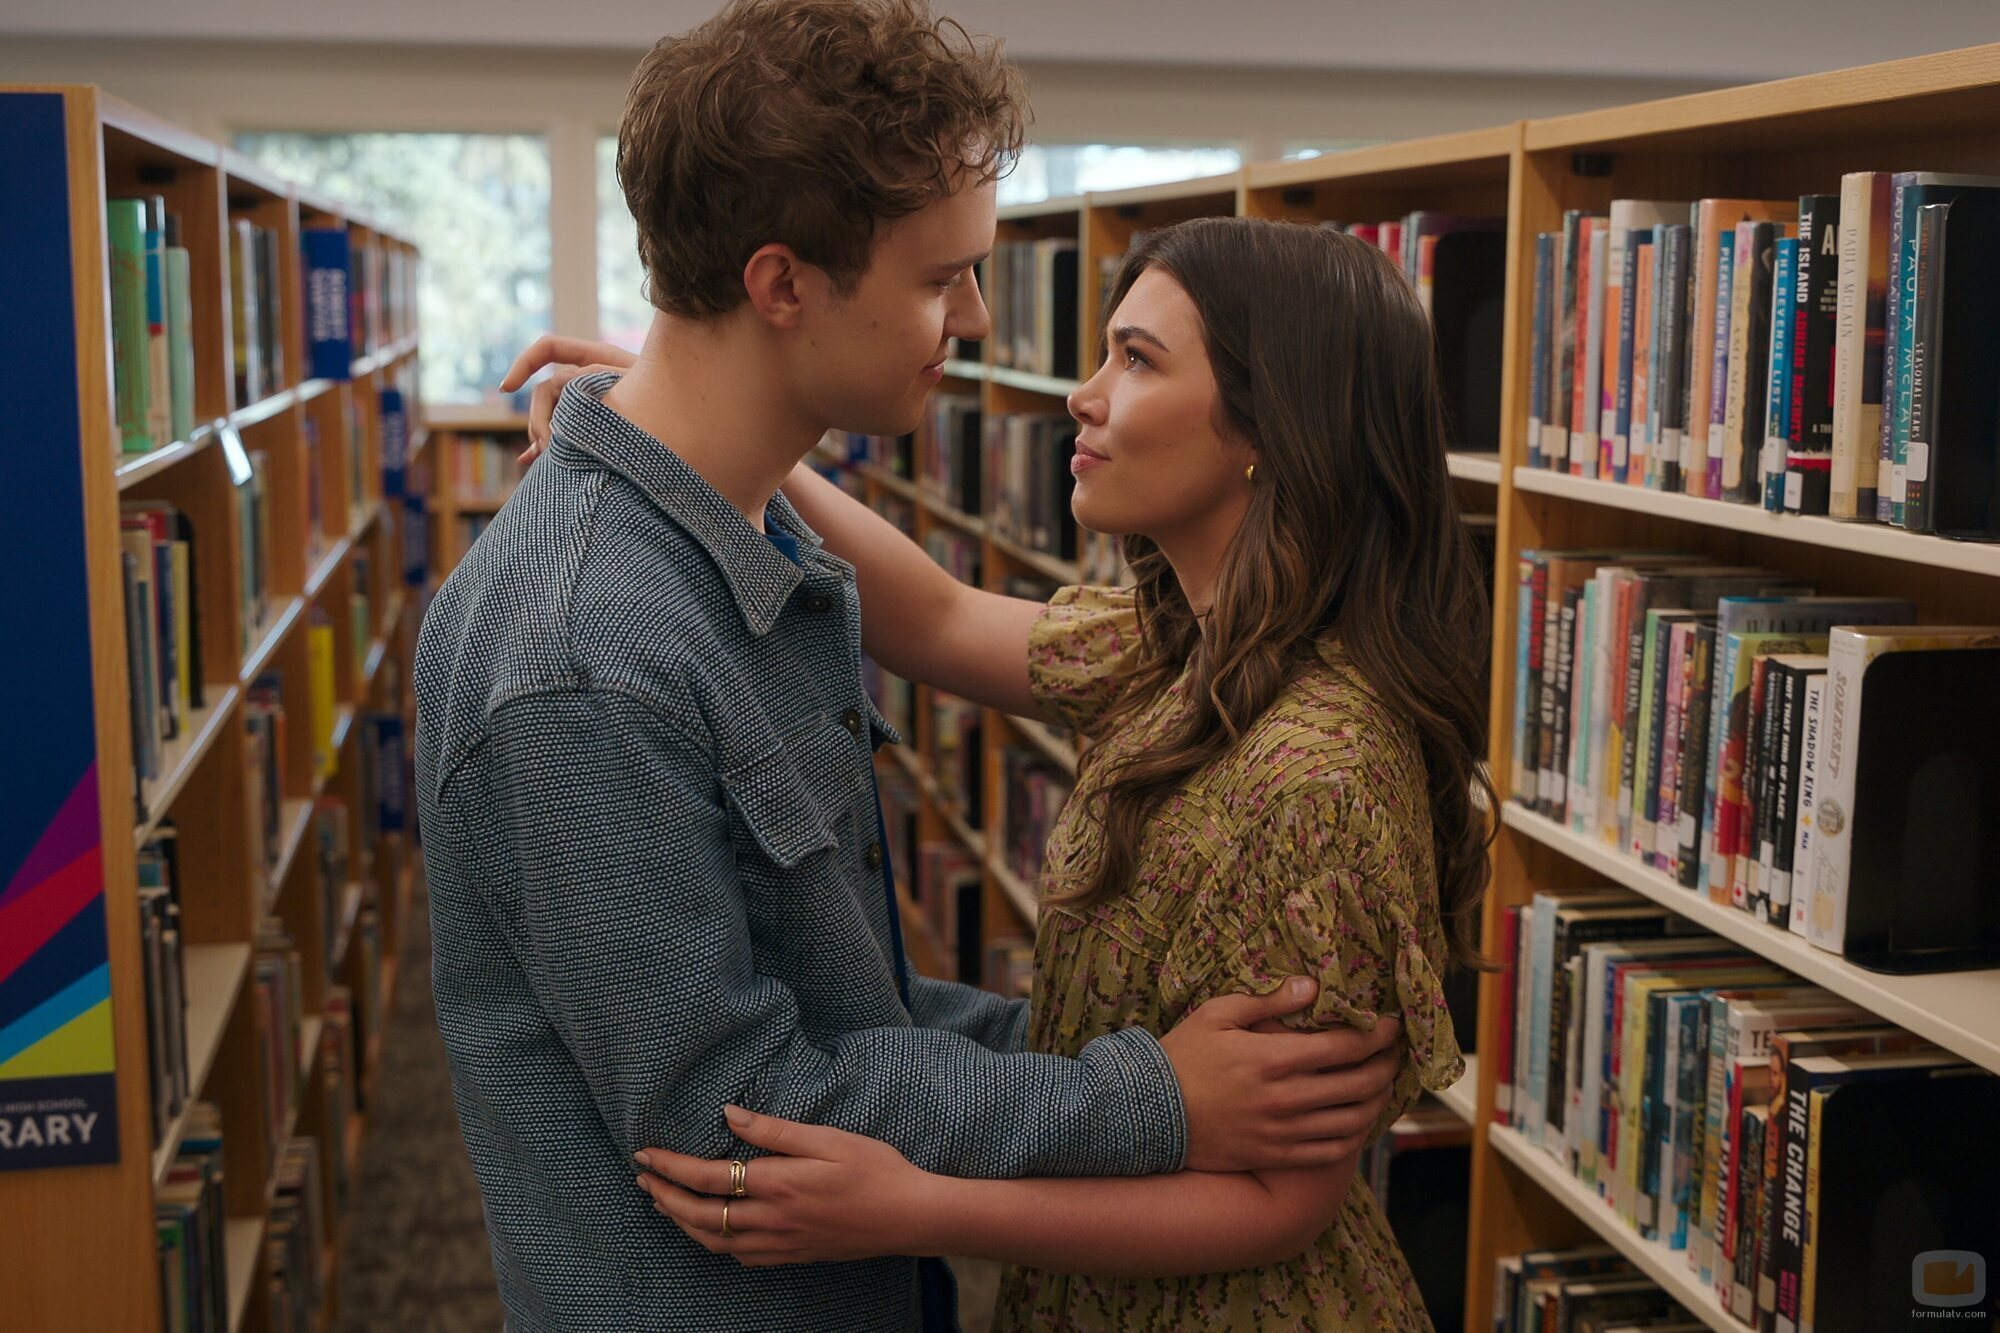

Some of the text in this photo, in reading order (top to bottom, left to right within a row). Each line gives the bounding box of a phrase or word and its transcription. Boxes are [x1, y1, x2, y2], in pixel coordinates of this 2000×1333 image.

[1800, 211, 1813, 241] THE
[1893, 185, 1905, 243] PAULA
[1718, 246, 1731, 297] PLEASE
[1779, 247, 1789, 278] THE
[1796, 246, 1811, 304] ISLAND
[1843, 228, 1858, 277] PAULA
[1890, 252, 1901, 317] McLAIN
[1904, 239, 1918, 332] PAULA
[1716, 303, 1728, 334] JOIN
[1774, 287, 1787, 362] REVENGE
[1793, 310, 1808, 367] ADRIAN
[1771, 369, 1781, 405] LIST
[1886, 345, 1895, 388] LOVE
[1914, 341, 1925, 398] SEASONAL
[1809, 690, 1820, 713] THE
[1828, 671, 1848, 779] SOMERSET
[1776, 675, 1794, 821] NOT THAT KIND OF PLACE
[1805, 718, 1818, 772] SHADOW
[1802, 775, 1814, 807] KING
[1710, 1015, 1726, 1049] SUE
[36, 1098, 88, 1112] SCHOOL
[1782, 1089, 1807, 1247] THE CHANGE
